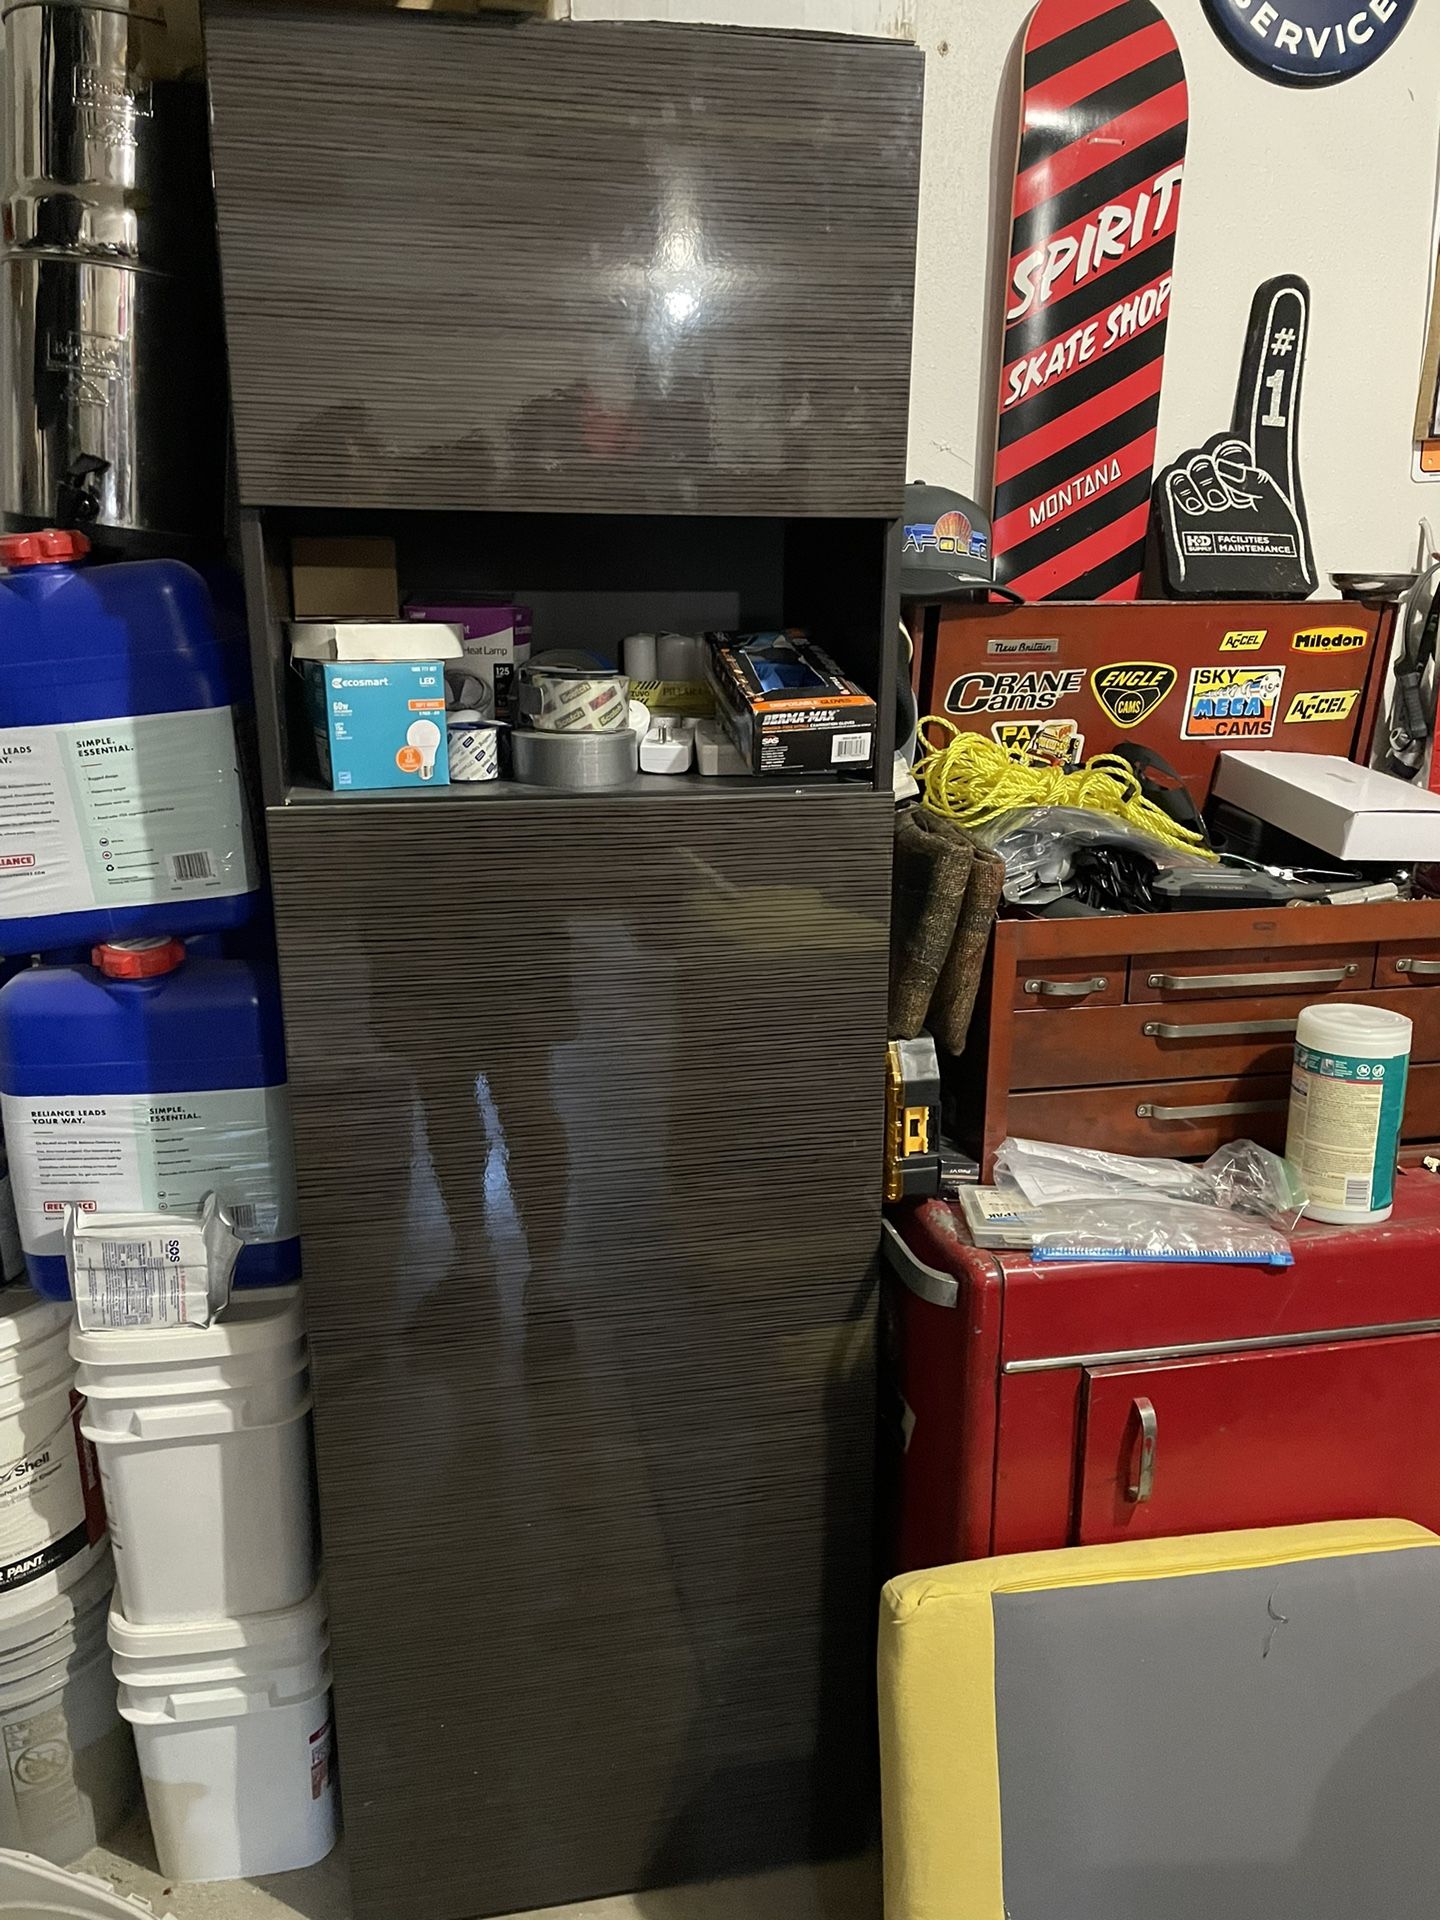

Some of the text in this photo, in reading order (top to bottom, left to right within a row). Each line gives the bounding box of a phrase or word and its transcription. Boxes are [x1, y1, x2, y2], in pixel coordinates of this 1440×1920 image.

[1007, 164, 1184, 321] SPIRIT
[1004, 276, 1173, 406] SKATE SHOP
[1261, 369, 1286, 427] 1
[1028, 458, 1123, 529] MONTANA
[1217, 535, 1270, 544] FACILITIES
[1219, 544, 1291, 553] MAINTENANCE
[995, 642, 1052, 652] New Britain
[1294, 634, 1364, 648] Milodon
[484, 647, 508, 656] Lamp
[496, 667, 510, 676] 125
[1193, 669, 1240, 684] ISKY
[342, 677, 389, 687] ecosmart
[419, 677, 436, 685] LED
[1100, 670, 1168, 687] ENGLE
[1117, 700, 1142, 714] CAMS
[1193, 696, 1264, 719] MEGA
[762, 709, 838, 726] DERMA-MAX
[1215, 721, 1272, 736] CAMS
[76, 737, 116, 750] SIMPLE.
[762, 736, 780, 746] SAS
[3, 746, 33, 755] LEADS
[78, 745, 135, 758] ESSENTIAL.
[31, 1109, 107, 1118] RELIANCE LEADS
[149, 1106, 186, 1115] SIMPLE.
[61, 1117, 86, 1125] WAY.
[150, 1112, 202, 1123] ESSENTIAL.
[14, 1451, 50, 1477] Shell
[6, 1553, 45, 1577] PAINT
